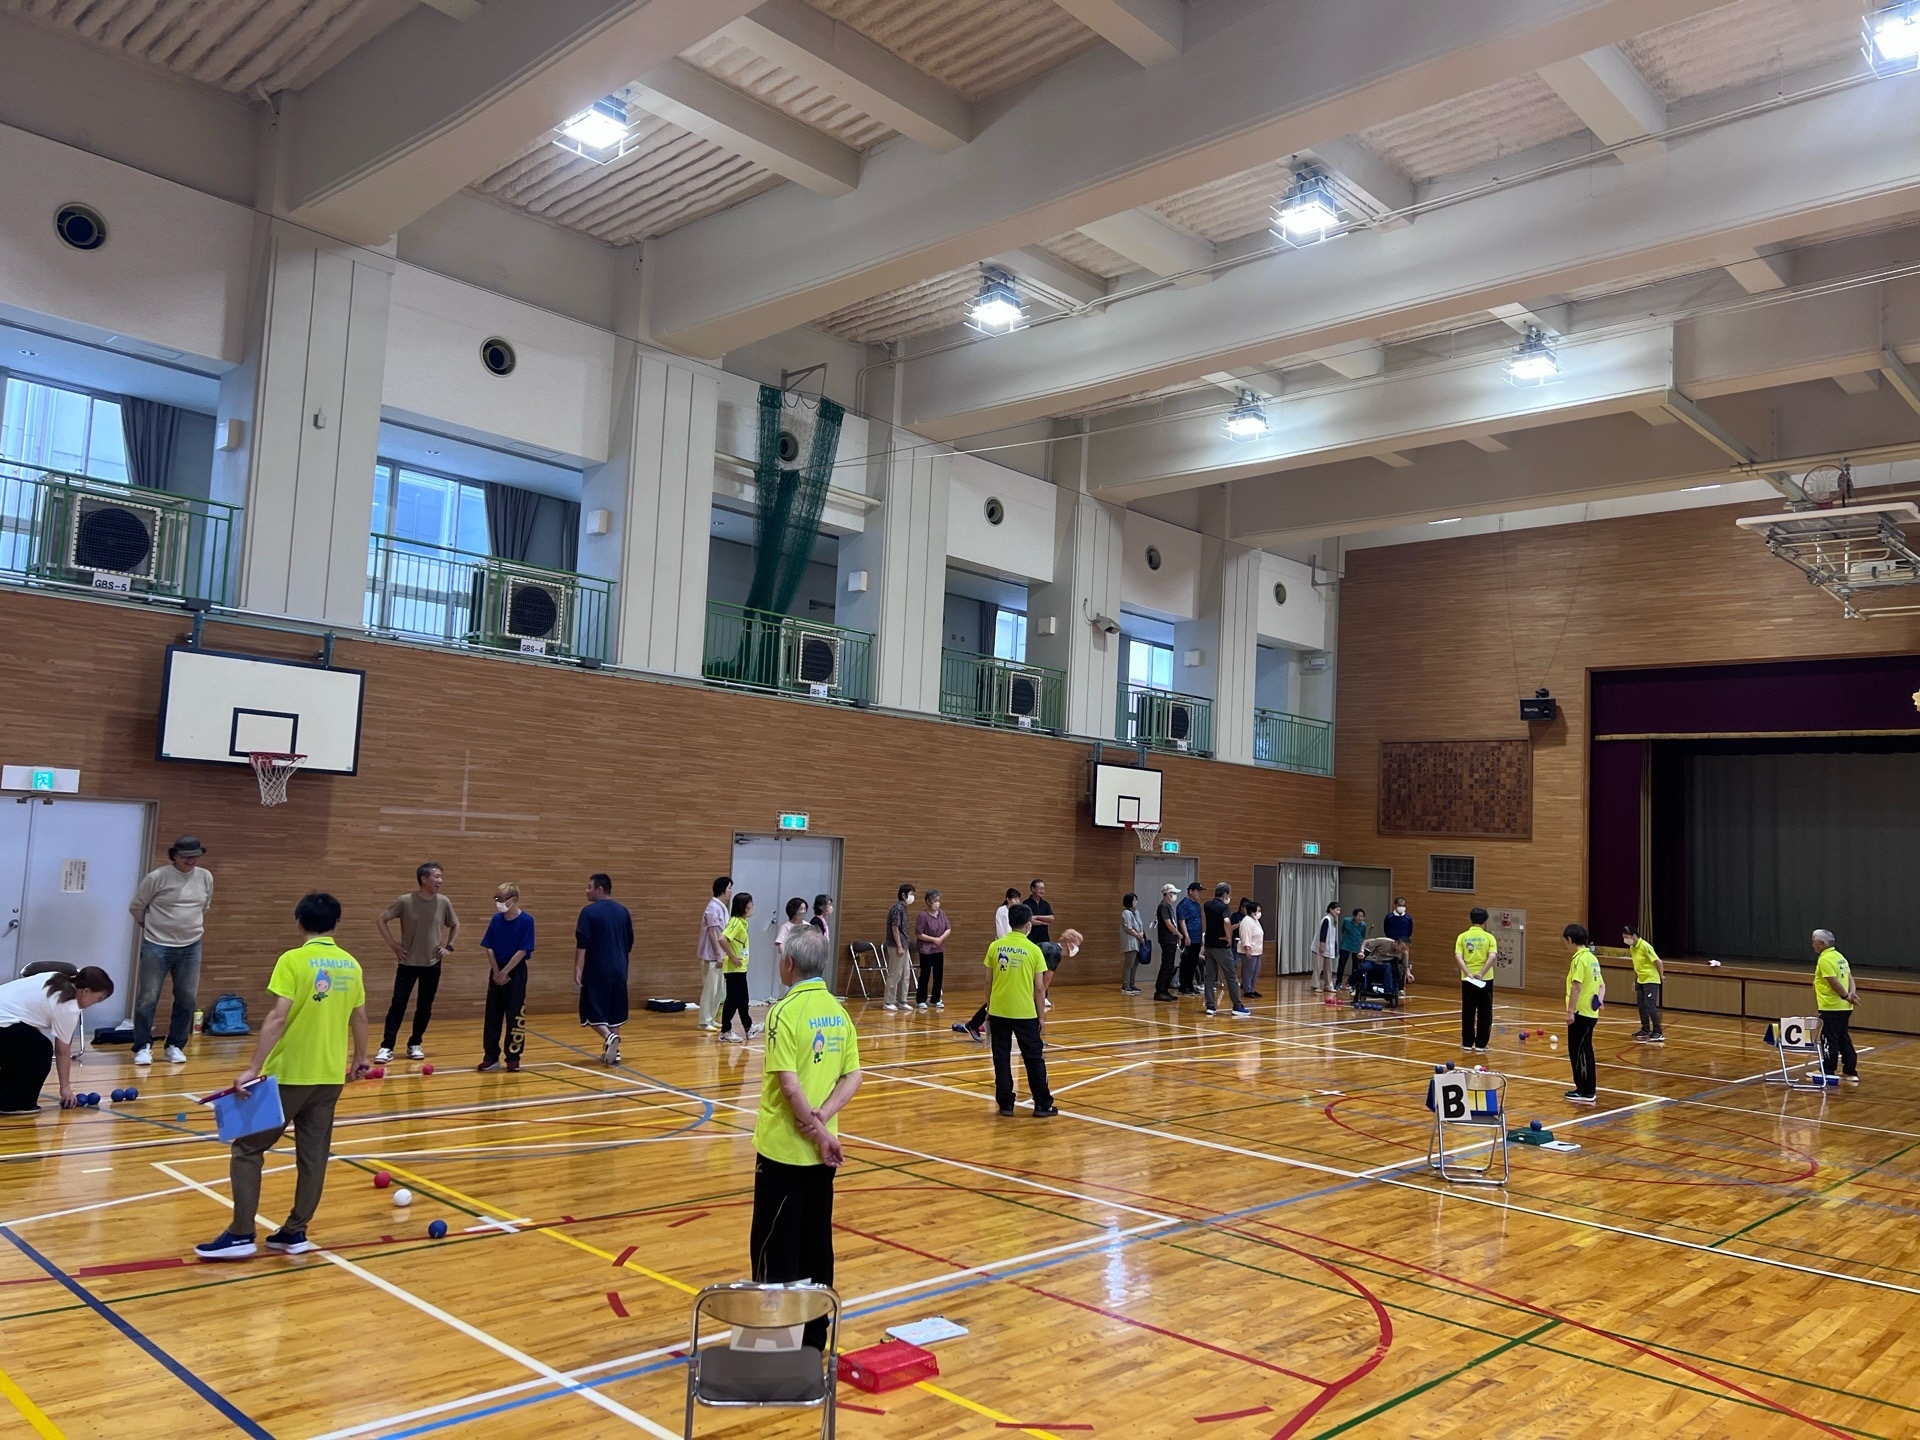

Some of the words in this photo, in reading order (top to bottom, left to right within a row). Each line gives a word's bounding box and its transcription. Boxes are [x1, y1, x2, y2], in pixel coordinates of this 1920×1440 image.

[95, 579, 127, 592] GBS-5
[522, 644, 544, 654] GBS-4
[997, 946, 1029, 956] HAMURA
[309, 958, 356, 969] HAMURA
[1784, 1024, 1803, 1045] C
[1441, 1084, 1466, 1119] B
